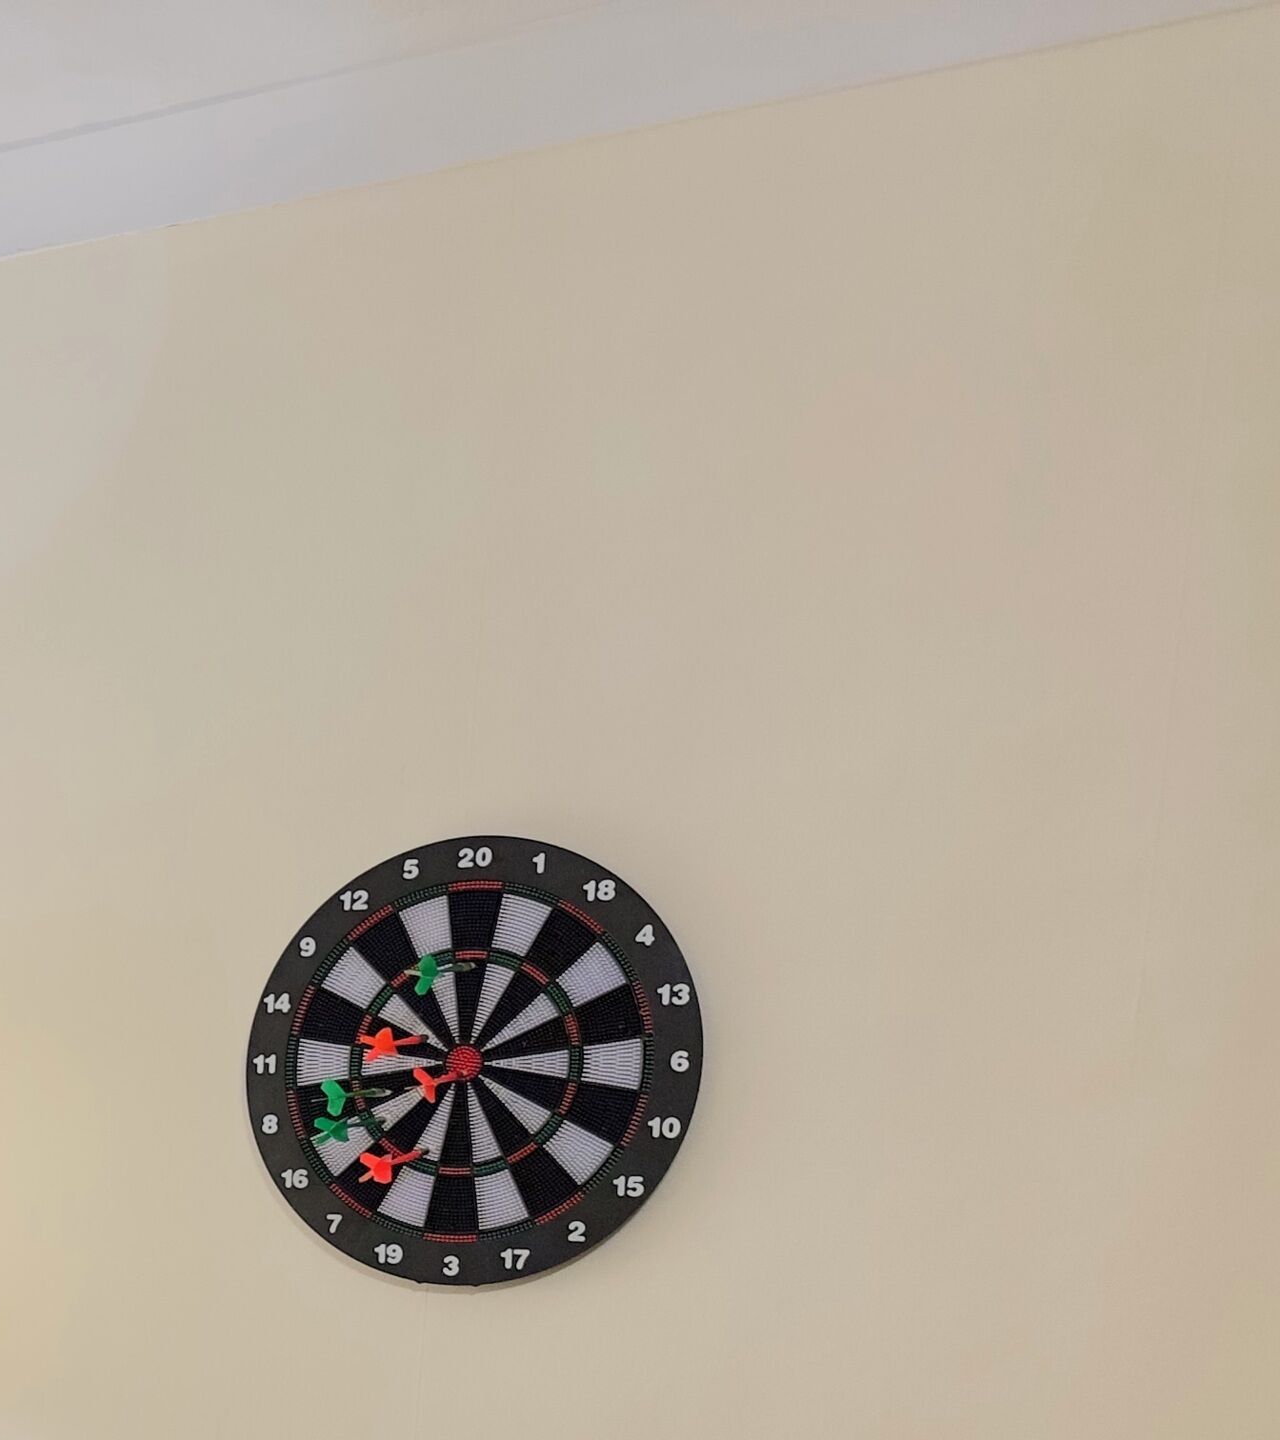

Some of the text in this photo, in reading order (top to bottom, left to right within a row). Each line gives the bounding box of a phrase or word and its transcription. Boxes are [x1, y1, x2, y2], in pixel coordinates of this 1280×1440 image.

[457, 846, 493, 868] 20
[532, 852, 546, 874] 1
[402, 858, 419, 880] 5
[339, 889, 369, 911] 12
[582, 879, 616, 902] 18
[635, 924, 655, 946] 4
[299, 936, 316, 957] 9
[263, 992, 291, 1014] 14
[656, 983, 690, 1006] 13
[252, 1054, 277, 1074] 11
[670, 1050, 690, 1073] 6
[261, 1114, 278, 1134] 8
[647, 1116, 681, 1139] 10
[280, 1168, 309, 1189] 16
[612, 1175, 645, 1198] 15
[326, 1214, 343, 1234] 7
[567, 1220, 586, 1242] 2
[374, 1243, 403, 1264] 19
[500, 1248, 531, 1270] 17
[442, 1255, 460, 1277] 3
